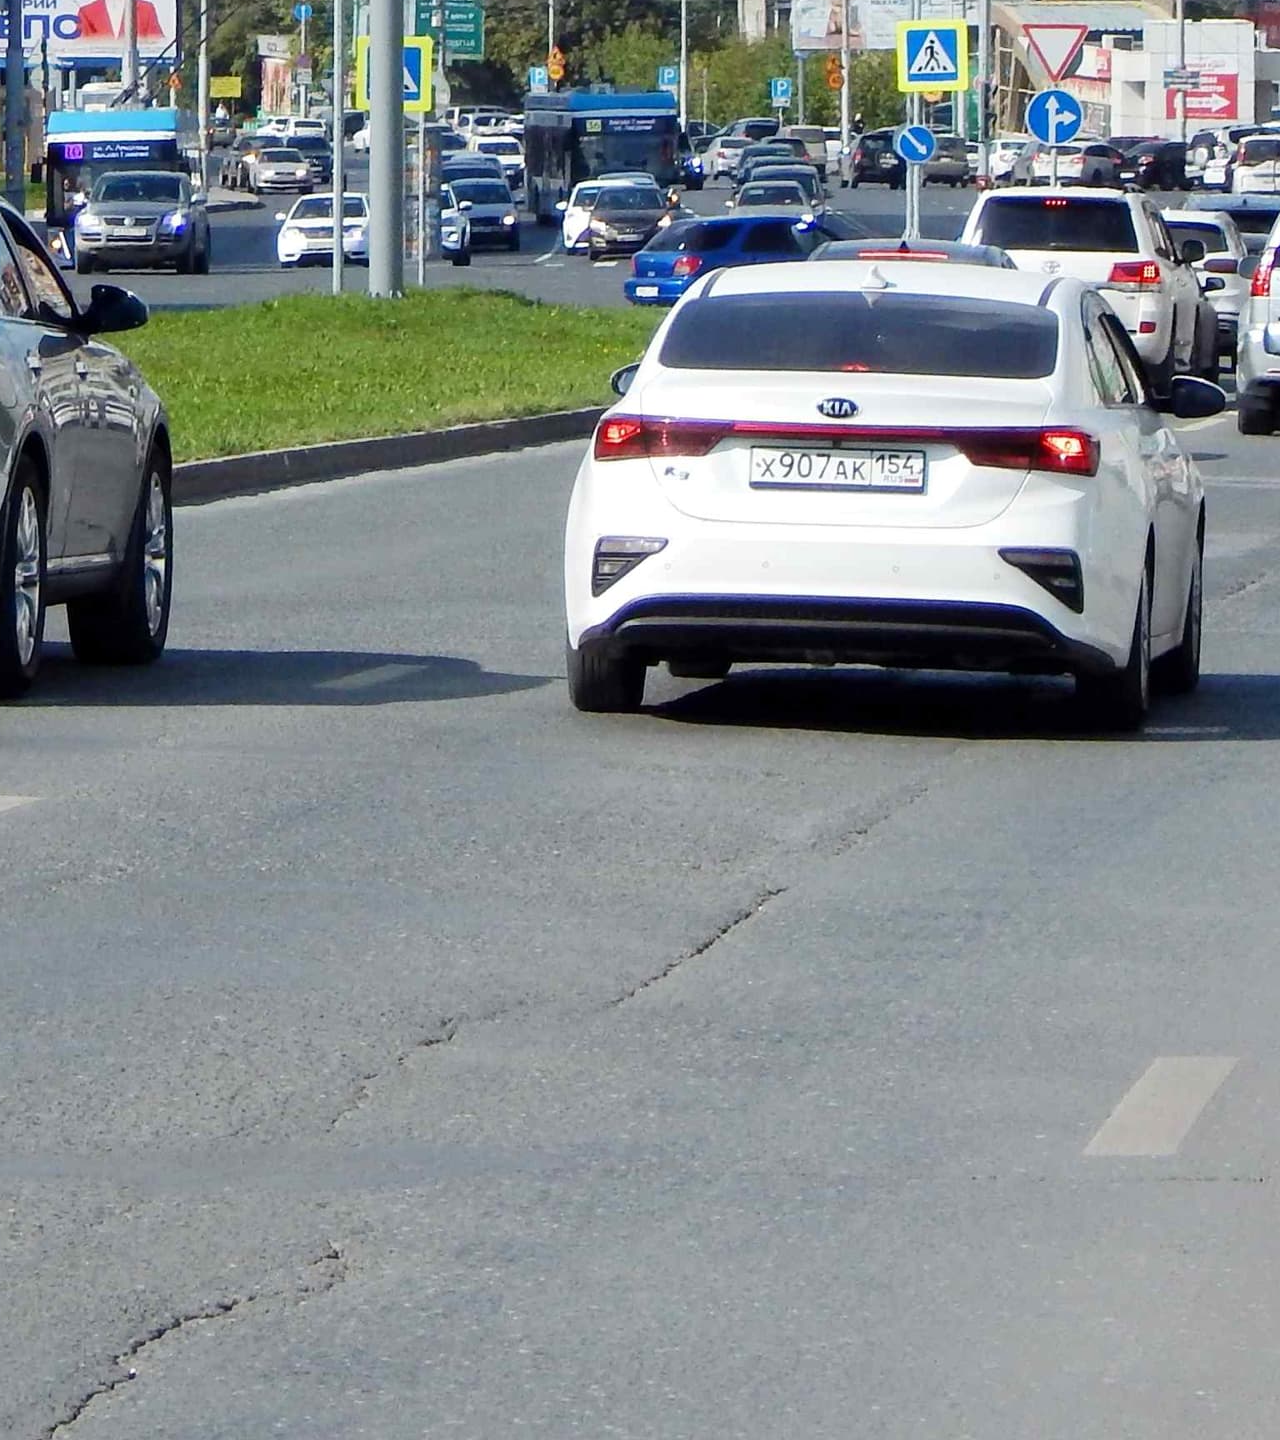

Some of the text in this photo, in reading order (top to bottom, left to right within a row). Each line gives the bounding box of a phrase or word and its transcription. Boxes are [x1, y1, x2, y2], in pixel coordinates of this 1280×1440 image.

[822, 401, 852, 415] KIA
[760, 453, 916, 481] Х907АК 154
